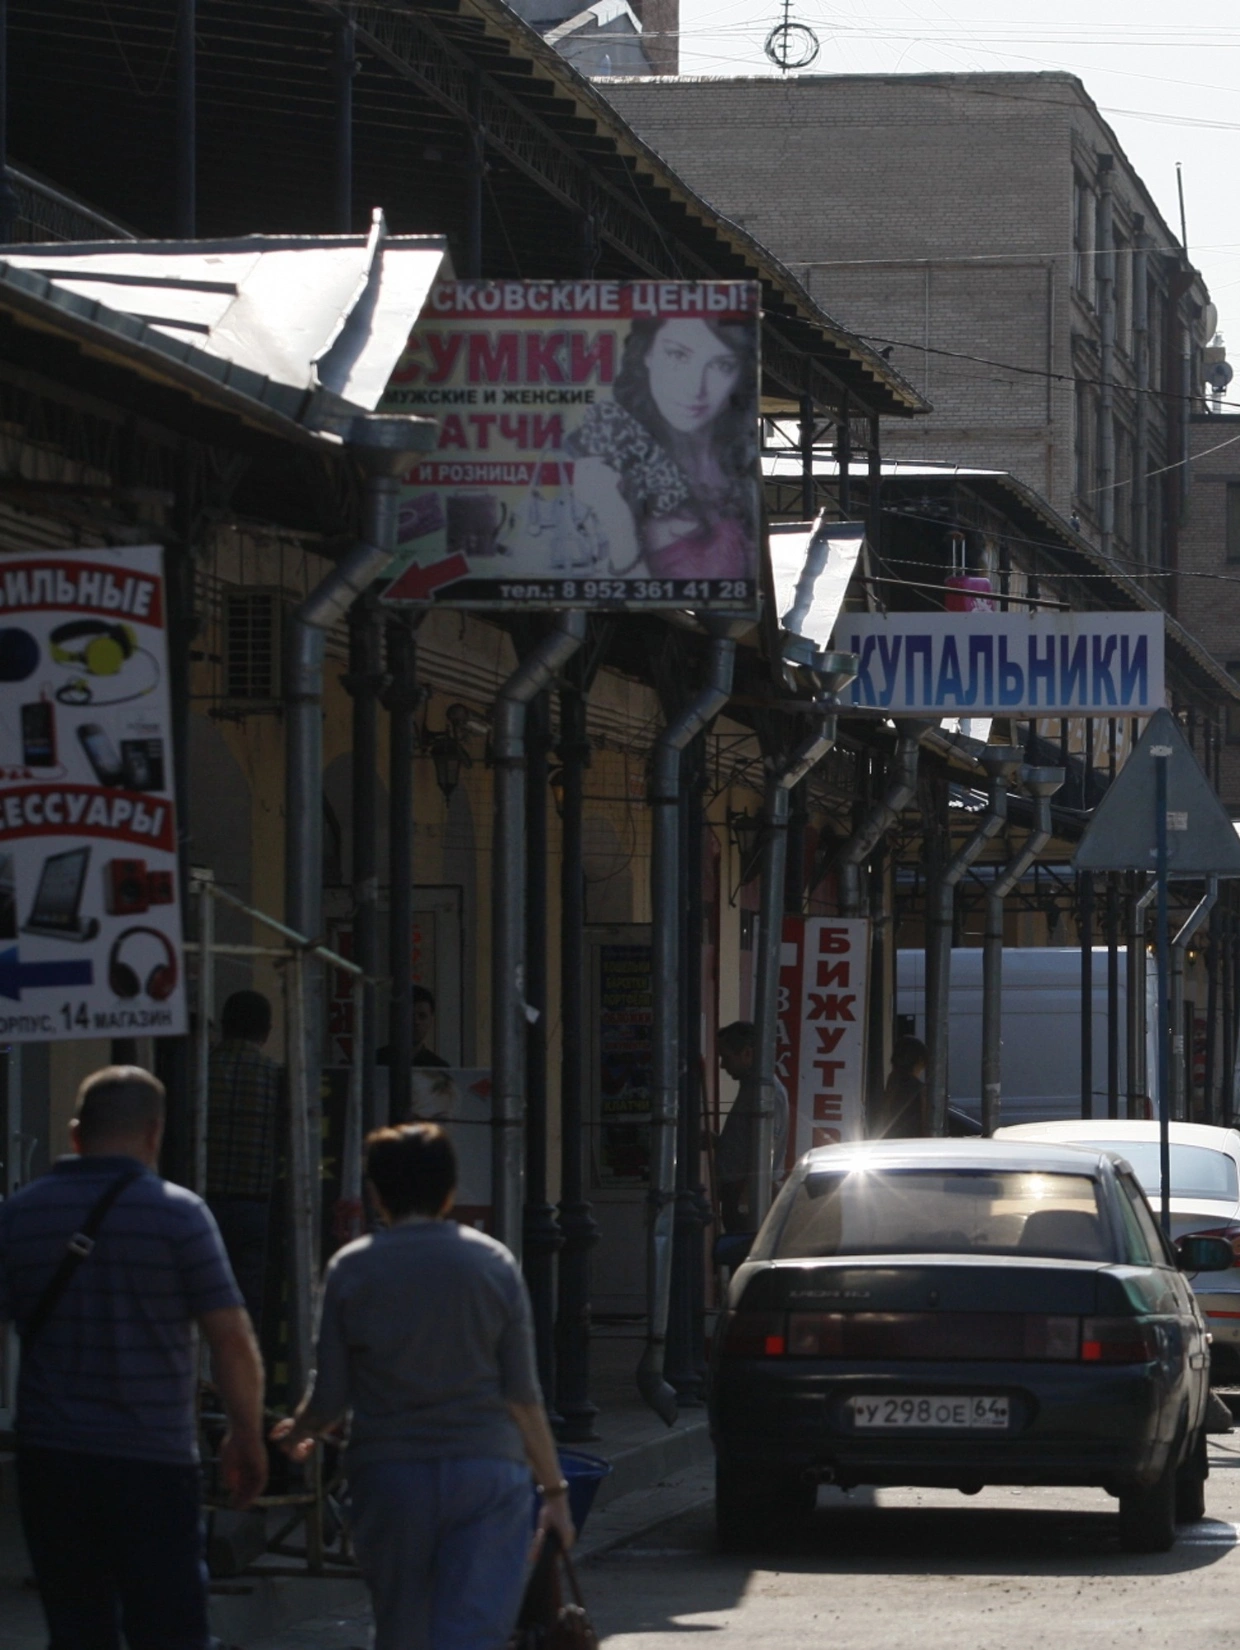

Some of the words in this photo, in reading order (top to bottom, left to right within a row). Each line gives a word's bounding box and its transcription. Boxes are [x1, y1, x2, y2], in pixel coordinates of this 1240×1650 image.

[432, 284, 620, 312] СКОВСКИЕ
[632, 283, 748, 316] ЦЕНЫ!
[391, 333, 614, 383] СУМКИ
[484, 390, 496, 404] И
[503, 390, 595, 404] ЖЕНСКИЕ
[437, 413, 562, 449] АТЧИ
[419, 463, 433, 480] И
[438, 463, 529, 483] РОЗНИЦА
[499, 582, 555, 598] тел.:
[562, 581, 576, 598] 8
[585, 581, 626, 598] 952
[634, 581, 674, 598] 361
[682, 581, 710, 598] 41
[718, 581, 747, 598] 28
[849, 633, 1148, 707] КУПАЛЬНИКИ
[0, 791, 165, 837] ЕССУАРЫ
[60, 1001, 90, 1030] 14
[94, 1010, 173, 1029] МАГАЗИН
[974, 1399, 1000, 1417] 64
